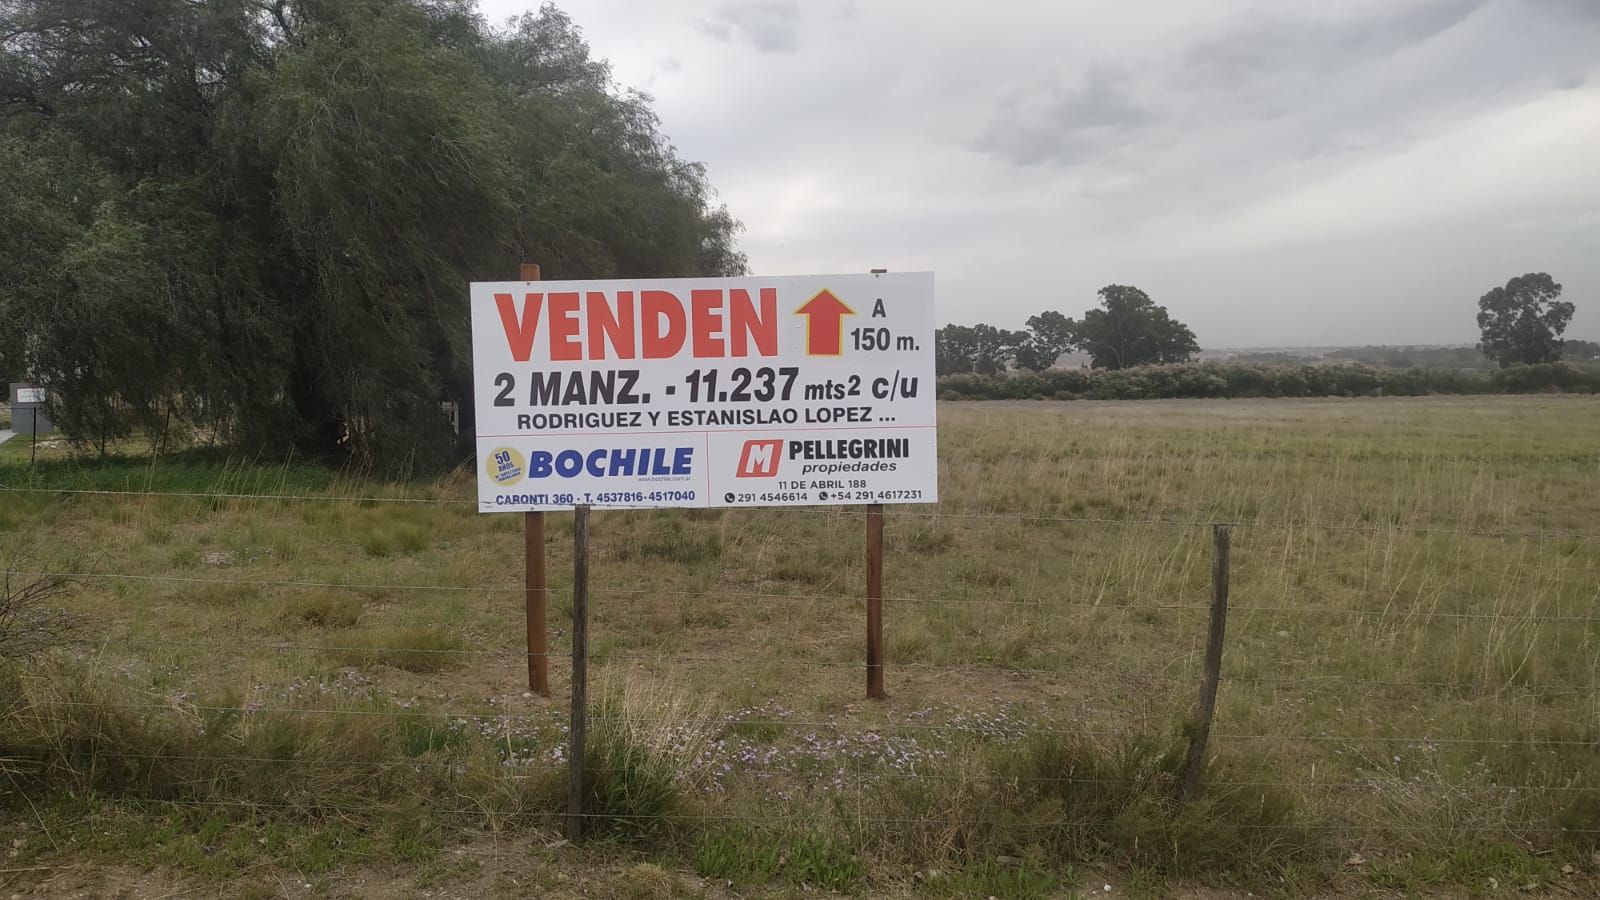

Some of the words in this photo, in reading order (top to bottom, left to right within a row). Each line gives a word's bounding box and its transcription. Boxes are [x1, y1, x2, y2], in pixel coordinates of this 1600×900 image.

[872, 298, 886, 318] A
[493, 288, 778, 362] VENDEN
[851, 328, 890, 351] 150
[896, 335, 920, 351] m.
[494, 372, 515, 407] 2
[530, 370, 651, 406] MANZ.
[685, 367, 799, 403] 11.237
[871, 369, 918, 402] c/u
[517, 412, 642, 429] RODRIGUEZ
[648, 411, 661, 426] Y
[668, 408, 798, 426] ESTANISLAO
[805, 407, 872, 423] LOPEZ
[495, 450, 511, 464] 50
[745, 443, 774, 473] M
[789, 438, 909, 460] PELLEGRINI
[528, 447, 694, 478] BOCHILE
[802, 460, 897, 475] propiedades
[778, 481, 787, 489] 11
[791, 480, 807, 489] DE
[810, 480, 845, 489] ABRIL
[848, 480, 867, 488] 188
[830, 491, 851, 500] +54
[855, 491, 874, 500] 291
[877, 489, 922, 499] 4617231
[496, 494, 549, 505] CARONTI
[552, 493, 574, 504] 360
[584, 493, 593, 503] T.
[738, 493, 756, 502] 291
[760, 492, 808, 501] 4546614
